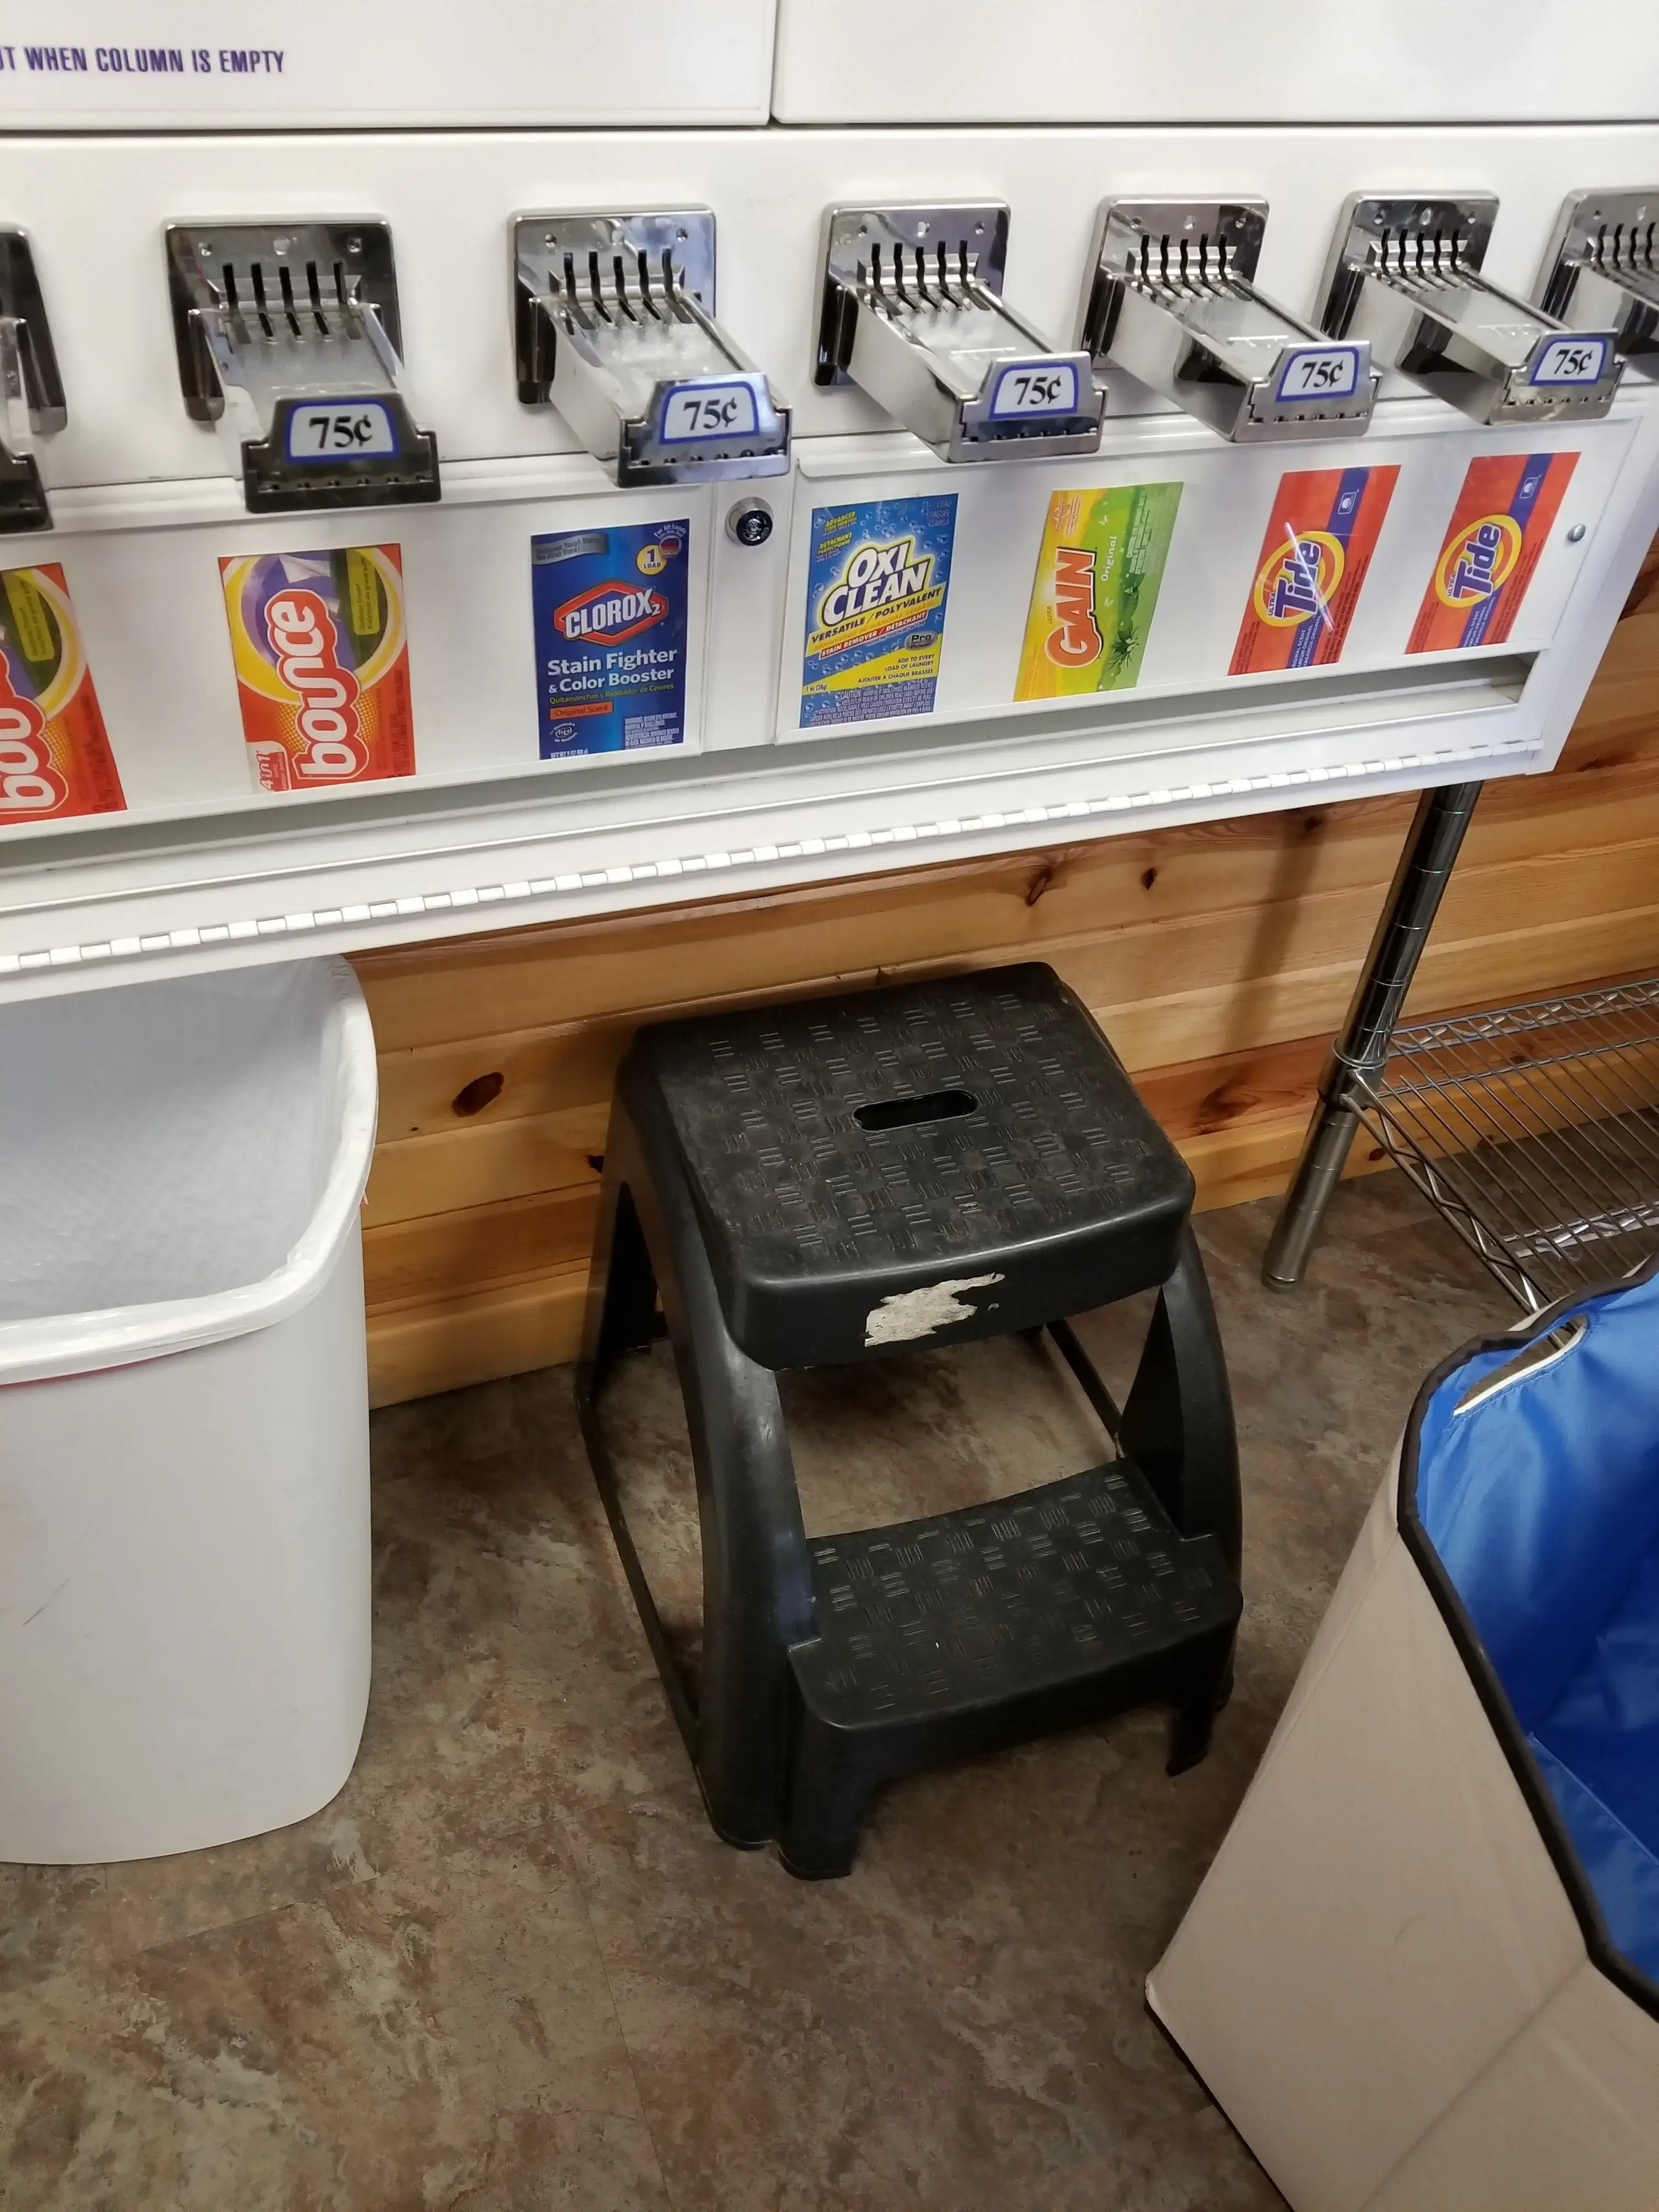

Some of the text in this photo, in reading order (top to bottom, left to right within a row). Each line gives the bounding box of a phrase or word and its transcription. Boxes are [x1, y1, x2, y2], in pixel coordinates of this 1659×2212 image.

[24, 47, 88, 71] WHEN
[95, 48, 184, 72] COLUMN
[191, 49, 211, 72] IS
[219, 50, 284, 72] EMPTY
[1301, 359, 1344, 388] 75¢
[1554, 349, 1594, 376] 75¢
[1014, 375, 1062, 405] 75¢
[683, 397, 737, 431] 75¢
[309, 414, 373, 449] 75¢
[646, 549, 656, 562] 1
[849, 543, 909, 583] OXI
[1101, 535, 1118, 582] Original
[1453, 524, 1501, 600] Tide
[823, 562, 930, 625] CLEAN
[1274, 540, 1321, 619] Tide
[1447, 574, 1456, 597] ULTRA
[566, 588, 654, 639] CLOROX
[812, 617, 865, 643] VERSATILE
[875, 588, 941, 619] POLYVALENT
[1045, 547, 1103, 668] GAIN
[821, 645, 842, 657] STAIN
[844, 631, 877, 648] REMOVER
[911, 634, 932, 642] Pro
[548, 649, 678, 675] Stain Fighter
[273, 601, 357, 778] bounce
[549, 668, 674, 693] & Color Booster
[550, 693, 598, 704] Quitamanchas
